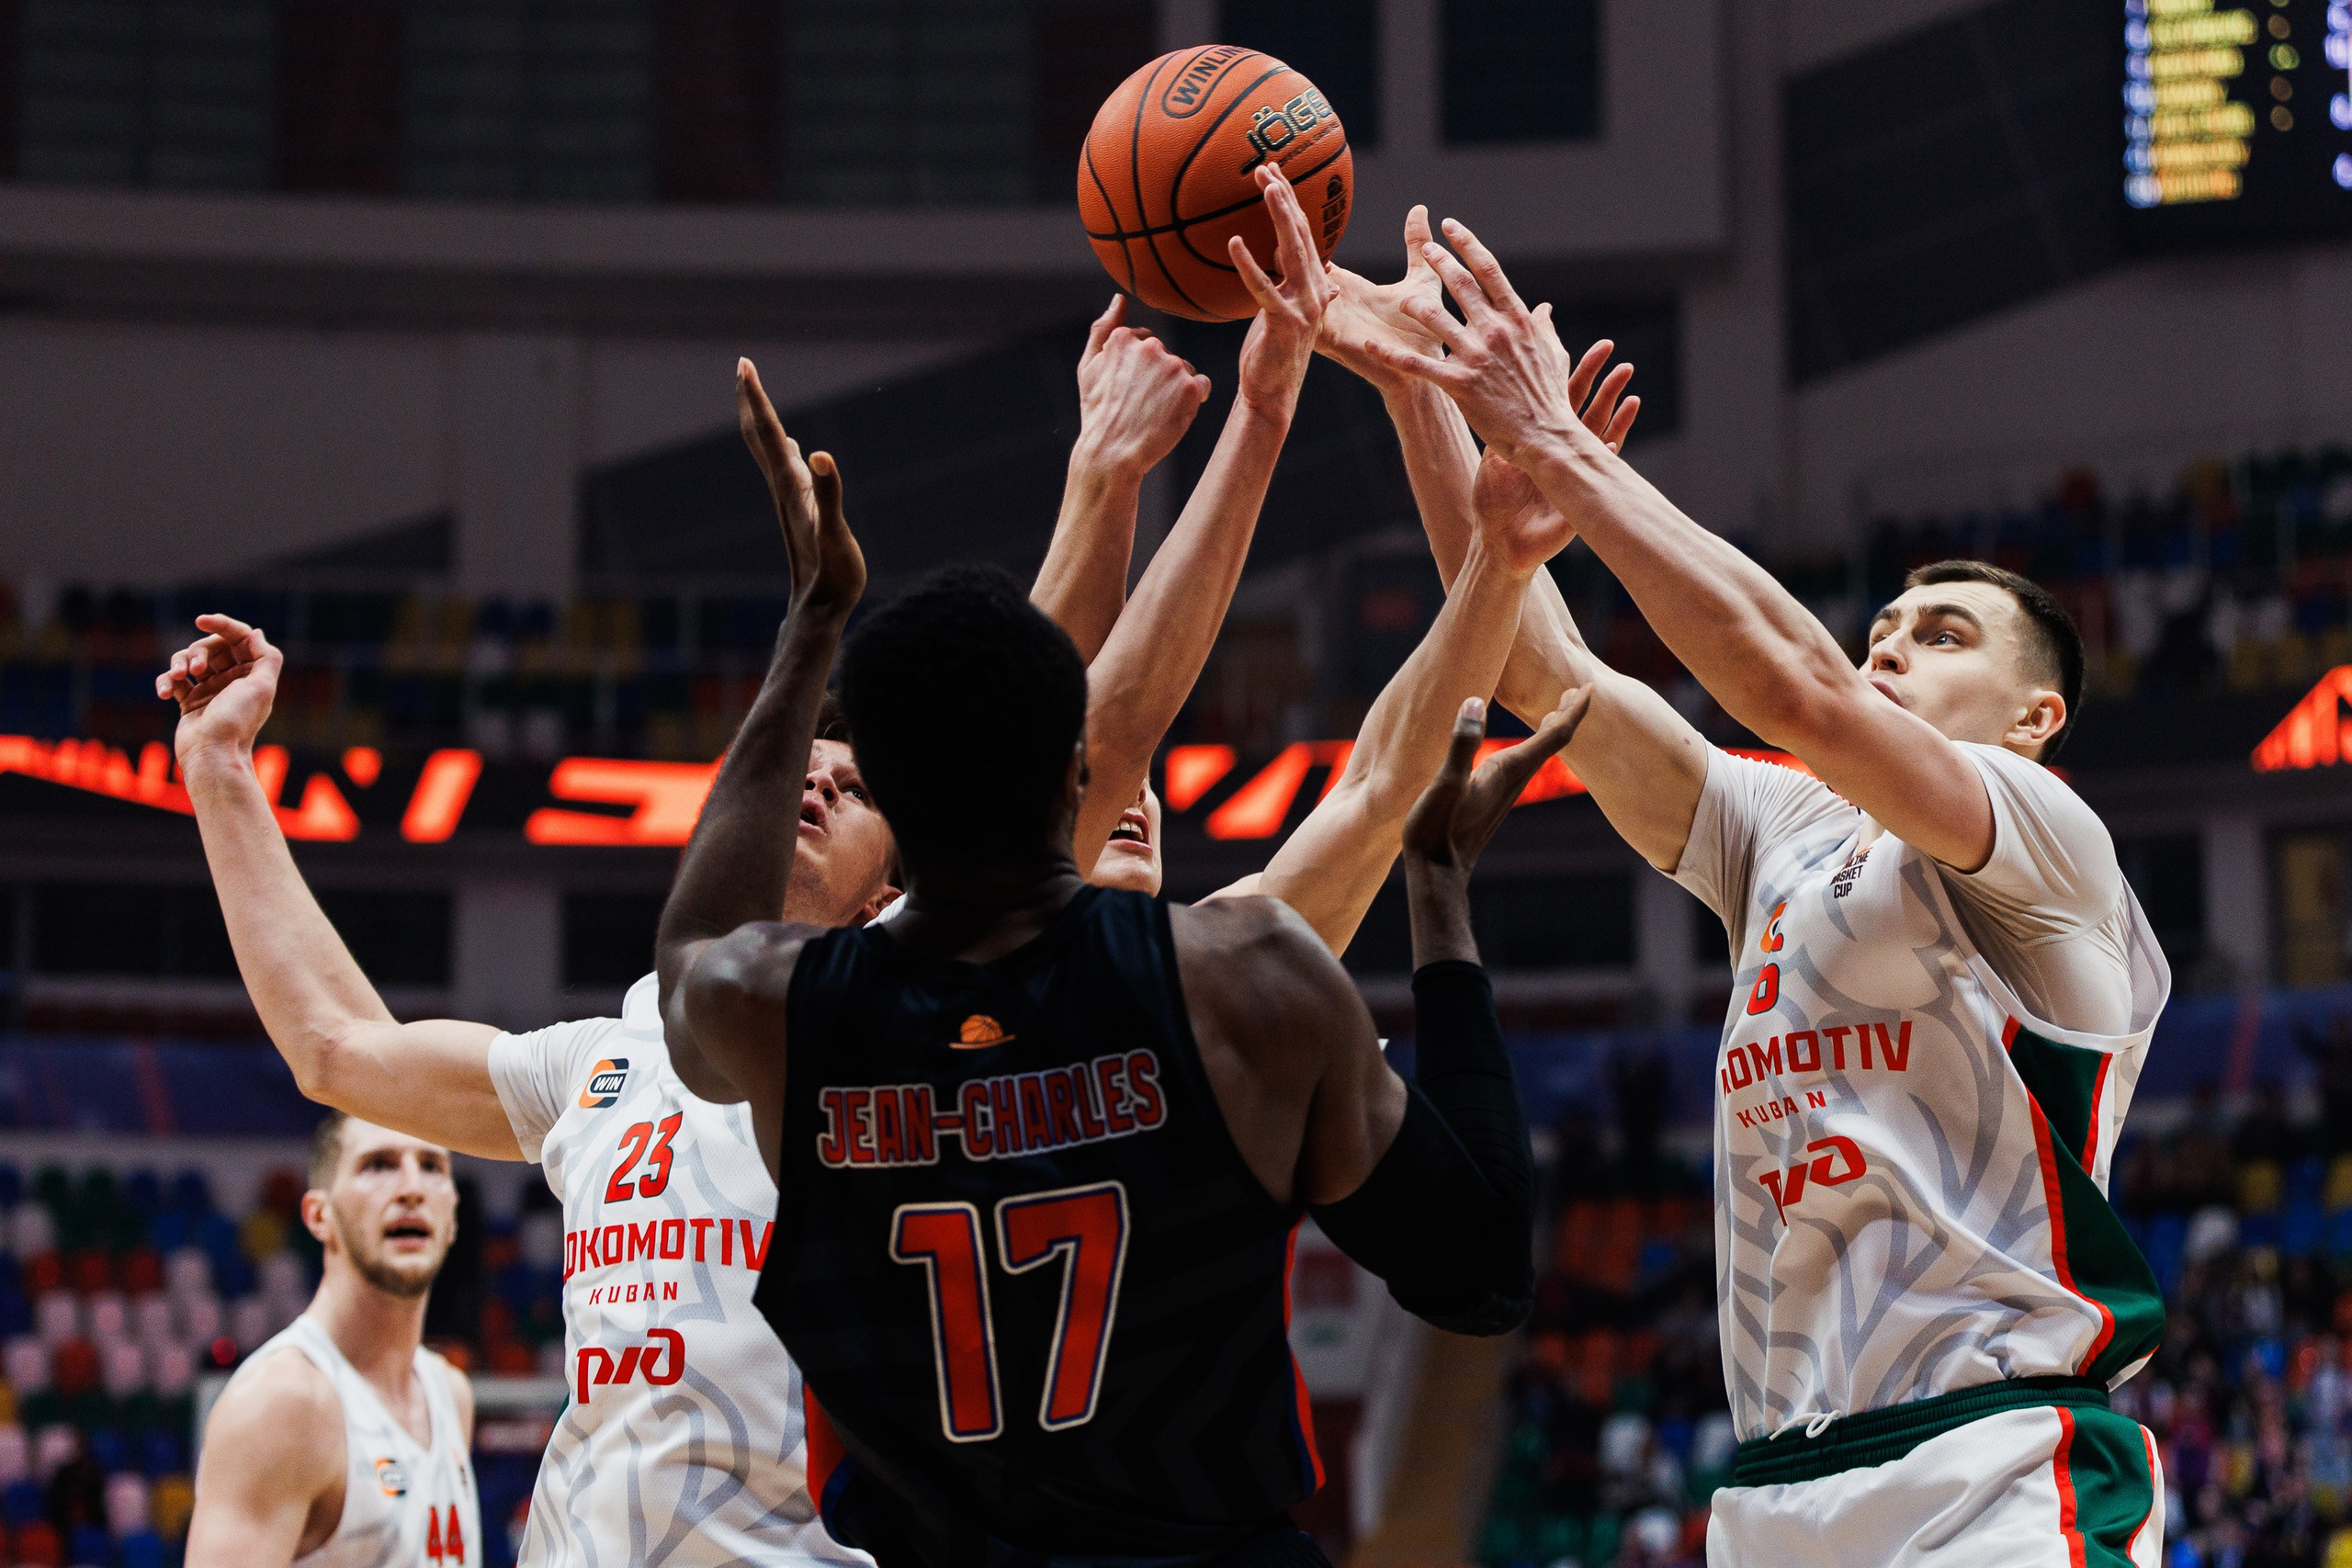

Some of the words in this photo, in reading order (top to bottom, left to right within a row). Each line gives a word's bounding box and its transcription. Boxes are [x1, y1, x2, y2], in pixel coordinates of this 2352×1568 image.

[1241, 86, 1332, 175] JÖGE
[1833, 882, 1853, 899] CUP
[594, 1076, 624, 1092] WIN
[817, 1048, 1167, 1168] JEAN-CHARLES
[1736, 1090, 1826, 1129] KUBAN
[604, 1111, 684, 1204] 23
[563, 1218, 776, 1286] OKOMOTIV
[589, 1281, 678, 1305] KUBAN
[889, 1179, 1132, 1443] 17
[426, 1503, 465, 1567] 44
